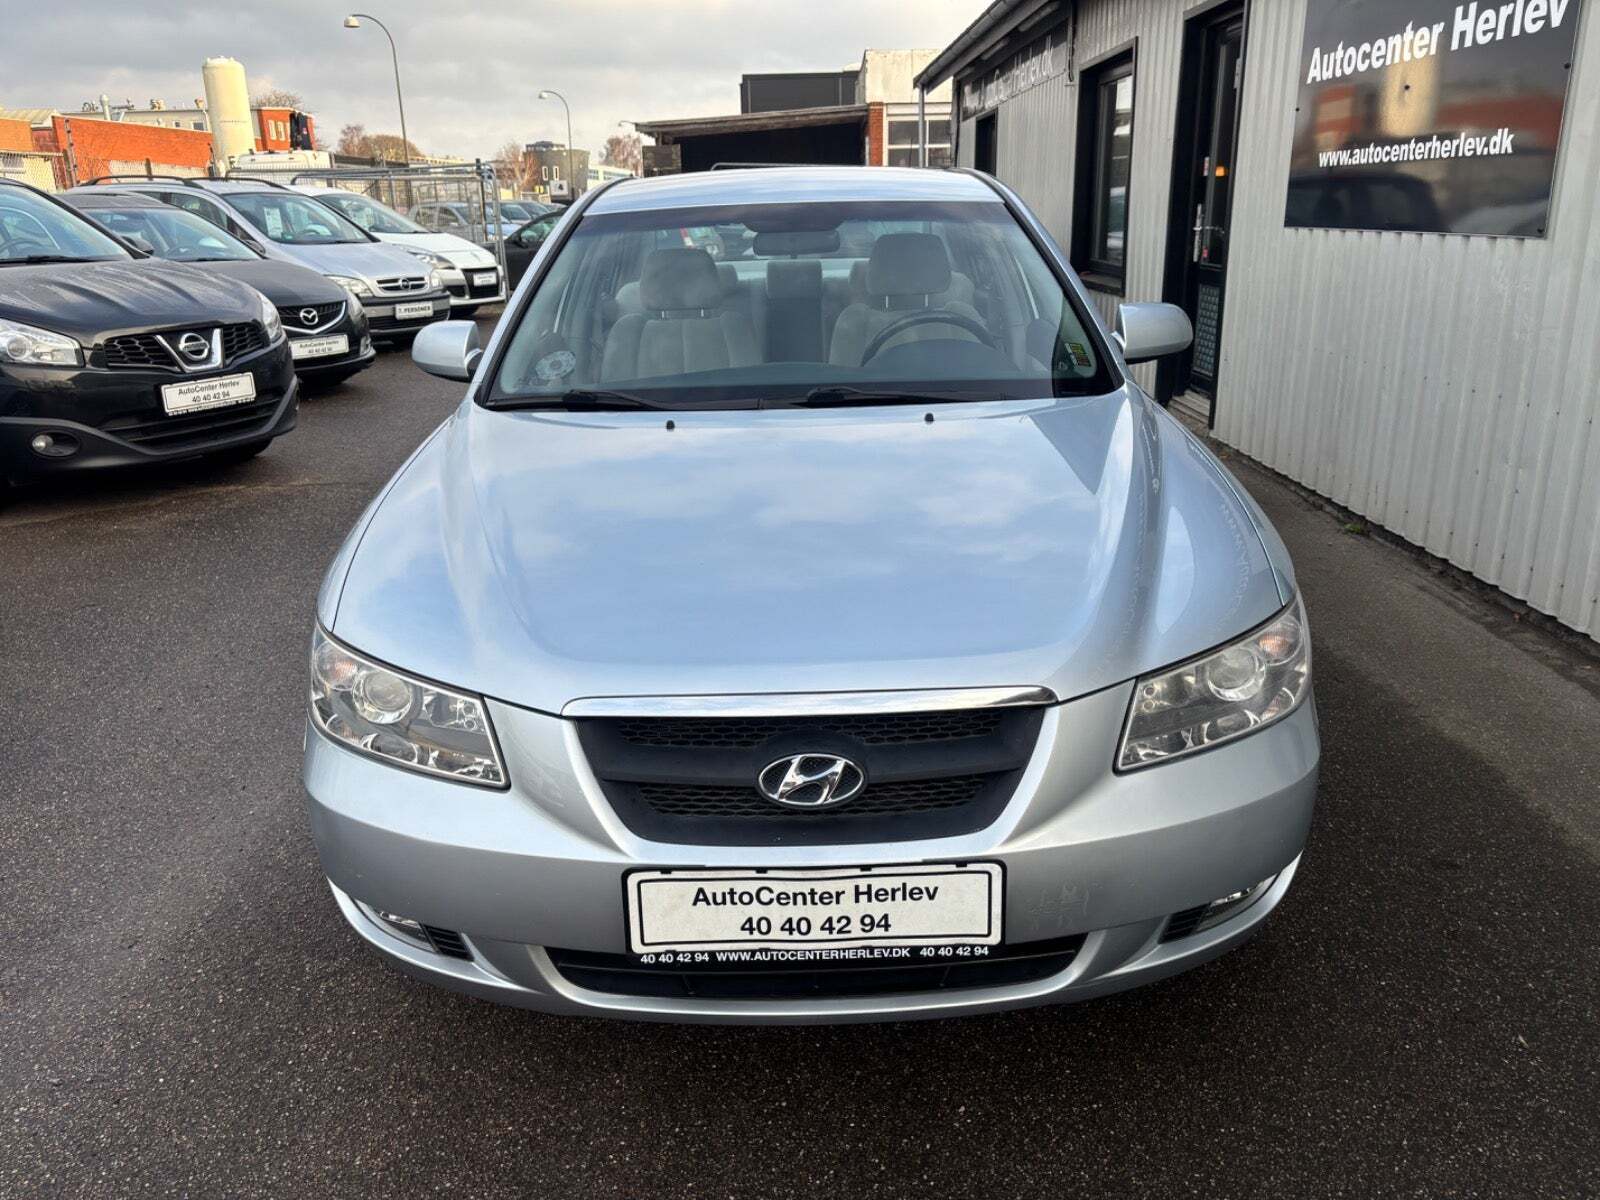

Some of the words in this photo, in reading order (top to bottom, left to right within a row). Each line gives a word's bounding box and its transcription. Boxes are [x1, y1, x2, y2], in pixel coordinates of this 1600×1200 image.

[1306, 20, 1445, 84] Autocenter
[1451, 0, 1568, 50] Herlev
[1319, 128, 1514, 168] www.autocenterherlev.dk
[178, 383, 218, 396] AutoCenter
[219, 380, 240, 390] Herlev
[192, 395, 201, 403] 40
[213, 392, 221, 400] 42
[692, 886, 845, 906] AutoCenter
[854, 882, 939, 904] Herlev
[740, 916, 772, 936] 40
[780, 916, 812, 936] 40
[820, 915, 852, 935] 42
[860, 913, 892, 933] 94
[640, 954, 656, 964] 40
[658, 953, 674, 963] 40
[676, 953, 692, 962] 42
[694, 952, 709, 962] 94
[715, 947, 911, 962] WWW.AUTOCENTERHERLEV.DK
[919, 946, 935, 957] 40
[937, 945, 952, 957] 40
[956, 945, 971, 956] 42
[973, 944, 989, 956] 94
